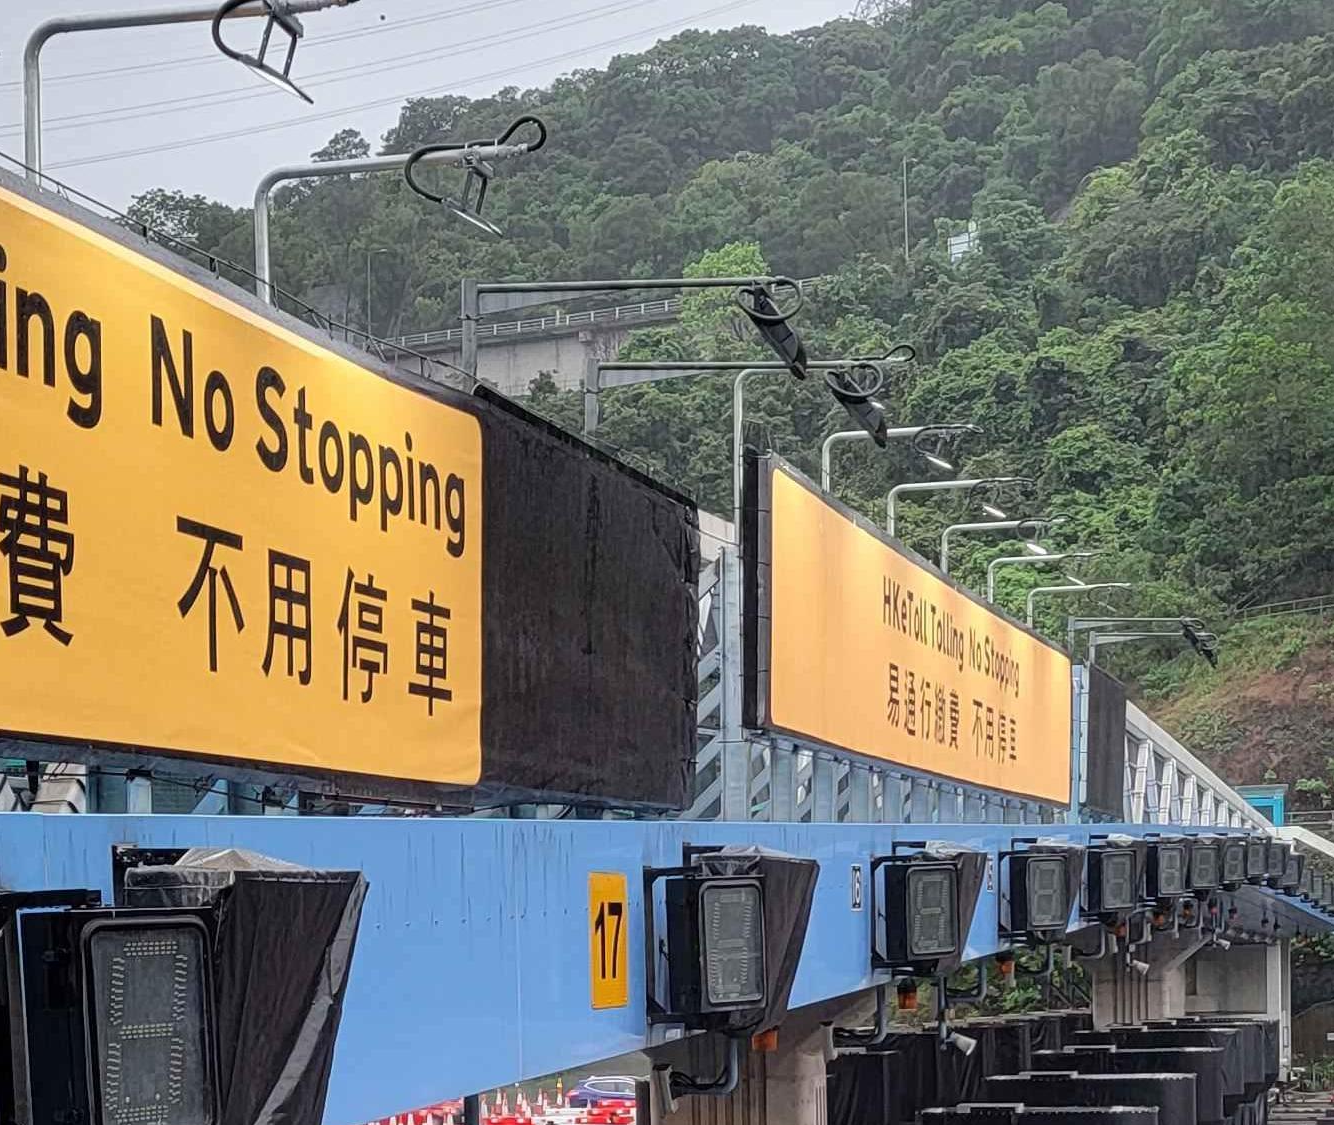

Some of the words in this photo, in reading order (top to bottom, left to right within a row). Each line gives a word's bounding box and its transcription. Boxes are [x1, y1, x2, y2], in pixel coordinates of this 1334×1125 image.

[150, 314, 234, 452] No
[253, 365, 466, 558] Stopping
[175, 515, 453, 717] 不用停車
[883, 575, 928, 646] HKeToll
[930, 603, 964, 674] Tolling
[969, 627, 981, 673] No
[984, 635, 1020, 699] Stopping
[594, 901, 623, 979] 17
